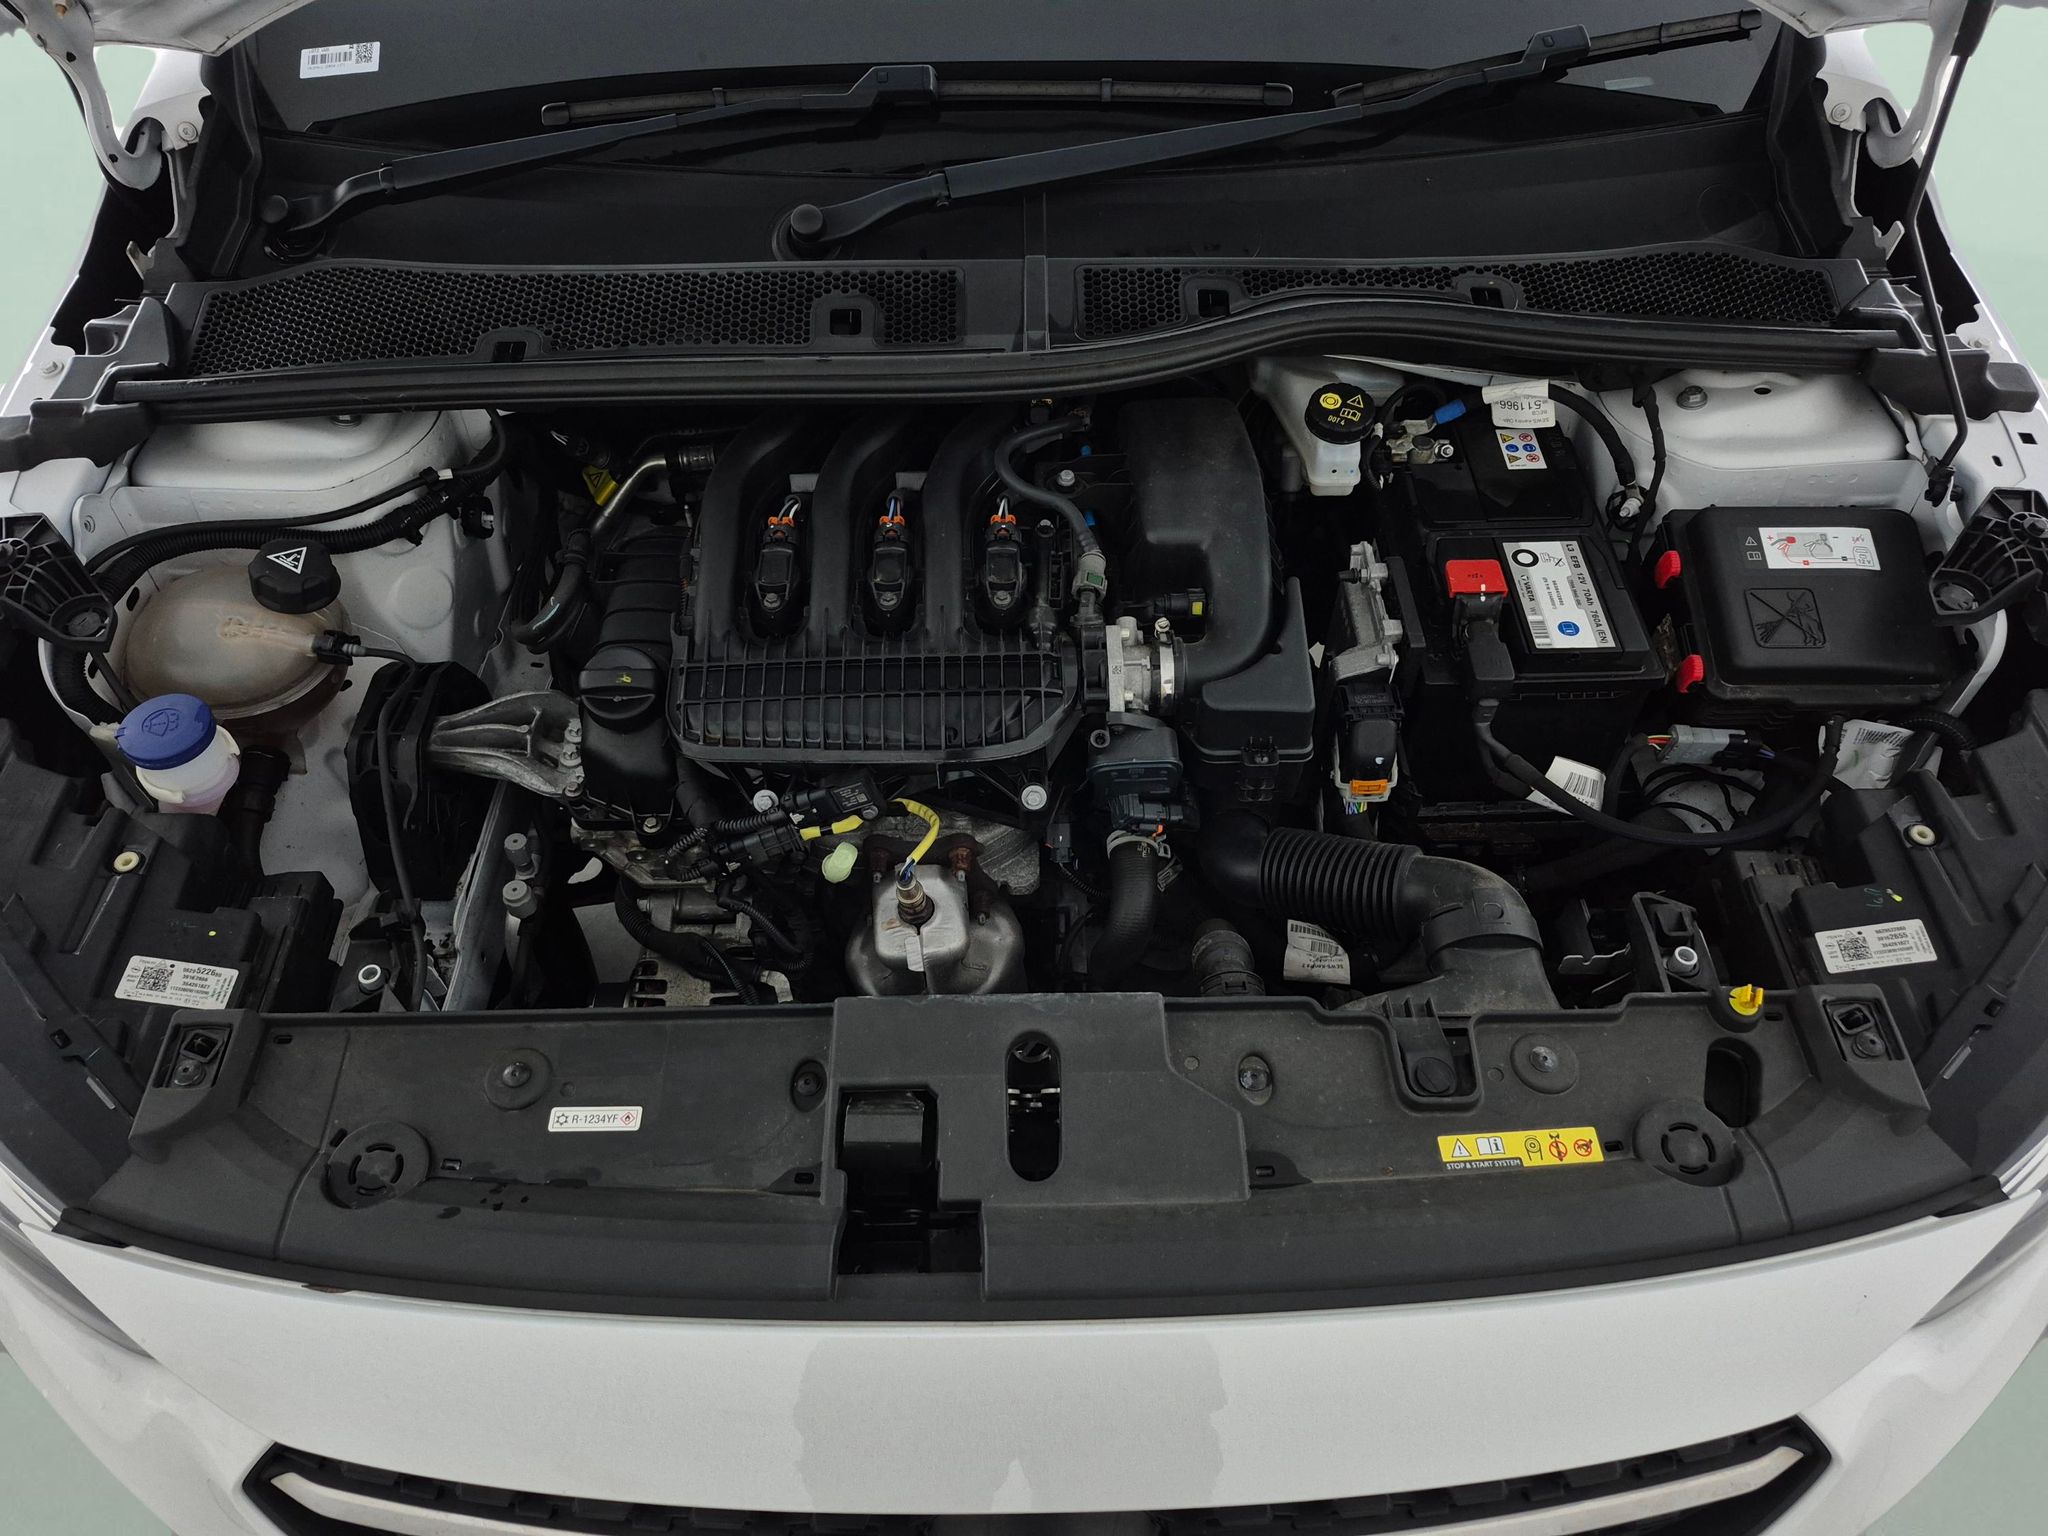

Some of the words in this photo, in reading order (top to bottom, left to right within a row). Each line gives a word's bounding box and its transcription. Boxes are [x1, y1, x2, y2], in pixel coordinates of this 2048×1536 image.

[1499, 400, 1542, 411] 511966
[1327, 414, 1341, 424] DOT
[1566, 543, 1575, 553] L3
[1570, 556, 1581, 569] EFB
[1576, 572, 1588, 585] 12V
[1523, 580, 1535, 602] VARTA
[1582, 588, 1595, 606] 70Ah
[1590, 609, 1603, 628] 760A
[1596, 628, 1609, 644] (EN)
[571, 1114, 619, 1124] R-1234YF
[1446, 1162, 1465, 1170] STOP
[1472, 1160, 1493, 1169] START
[1493, 1159, 1521, 1168] SYSTEM
